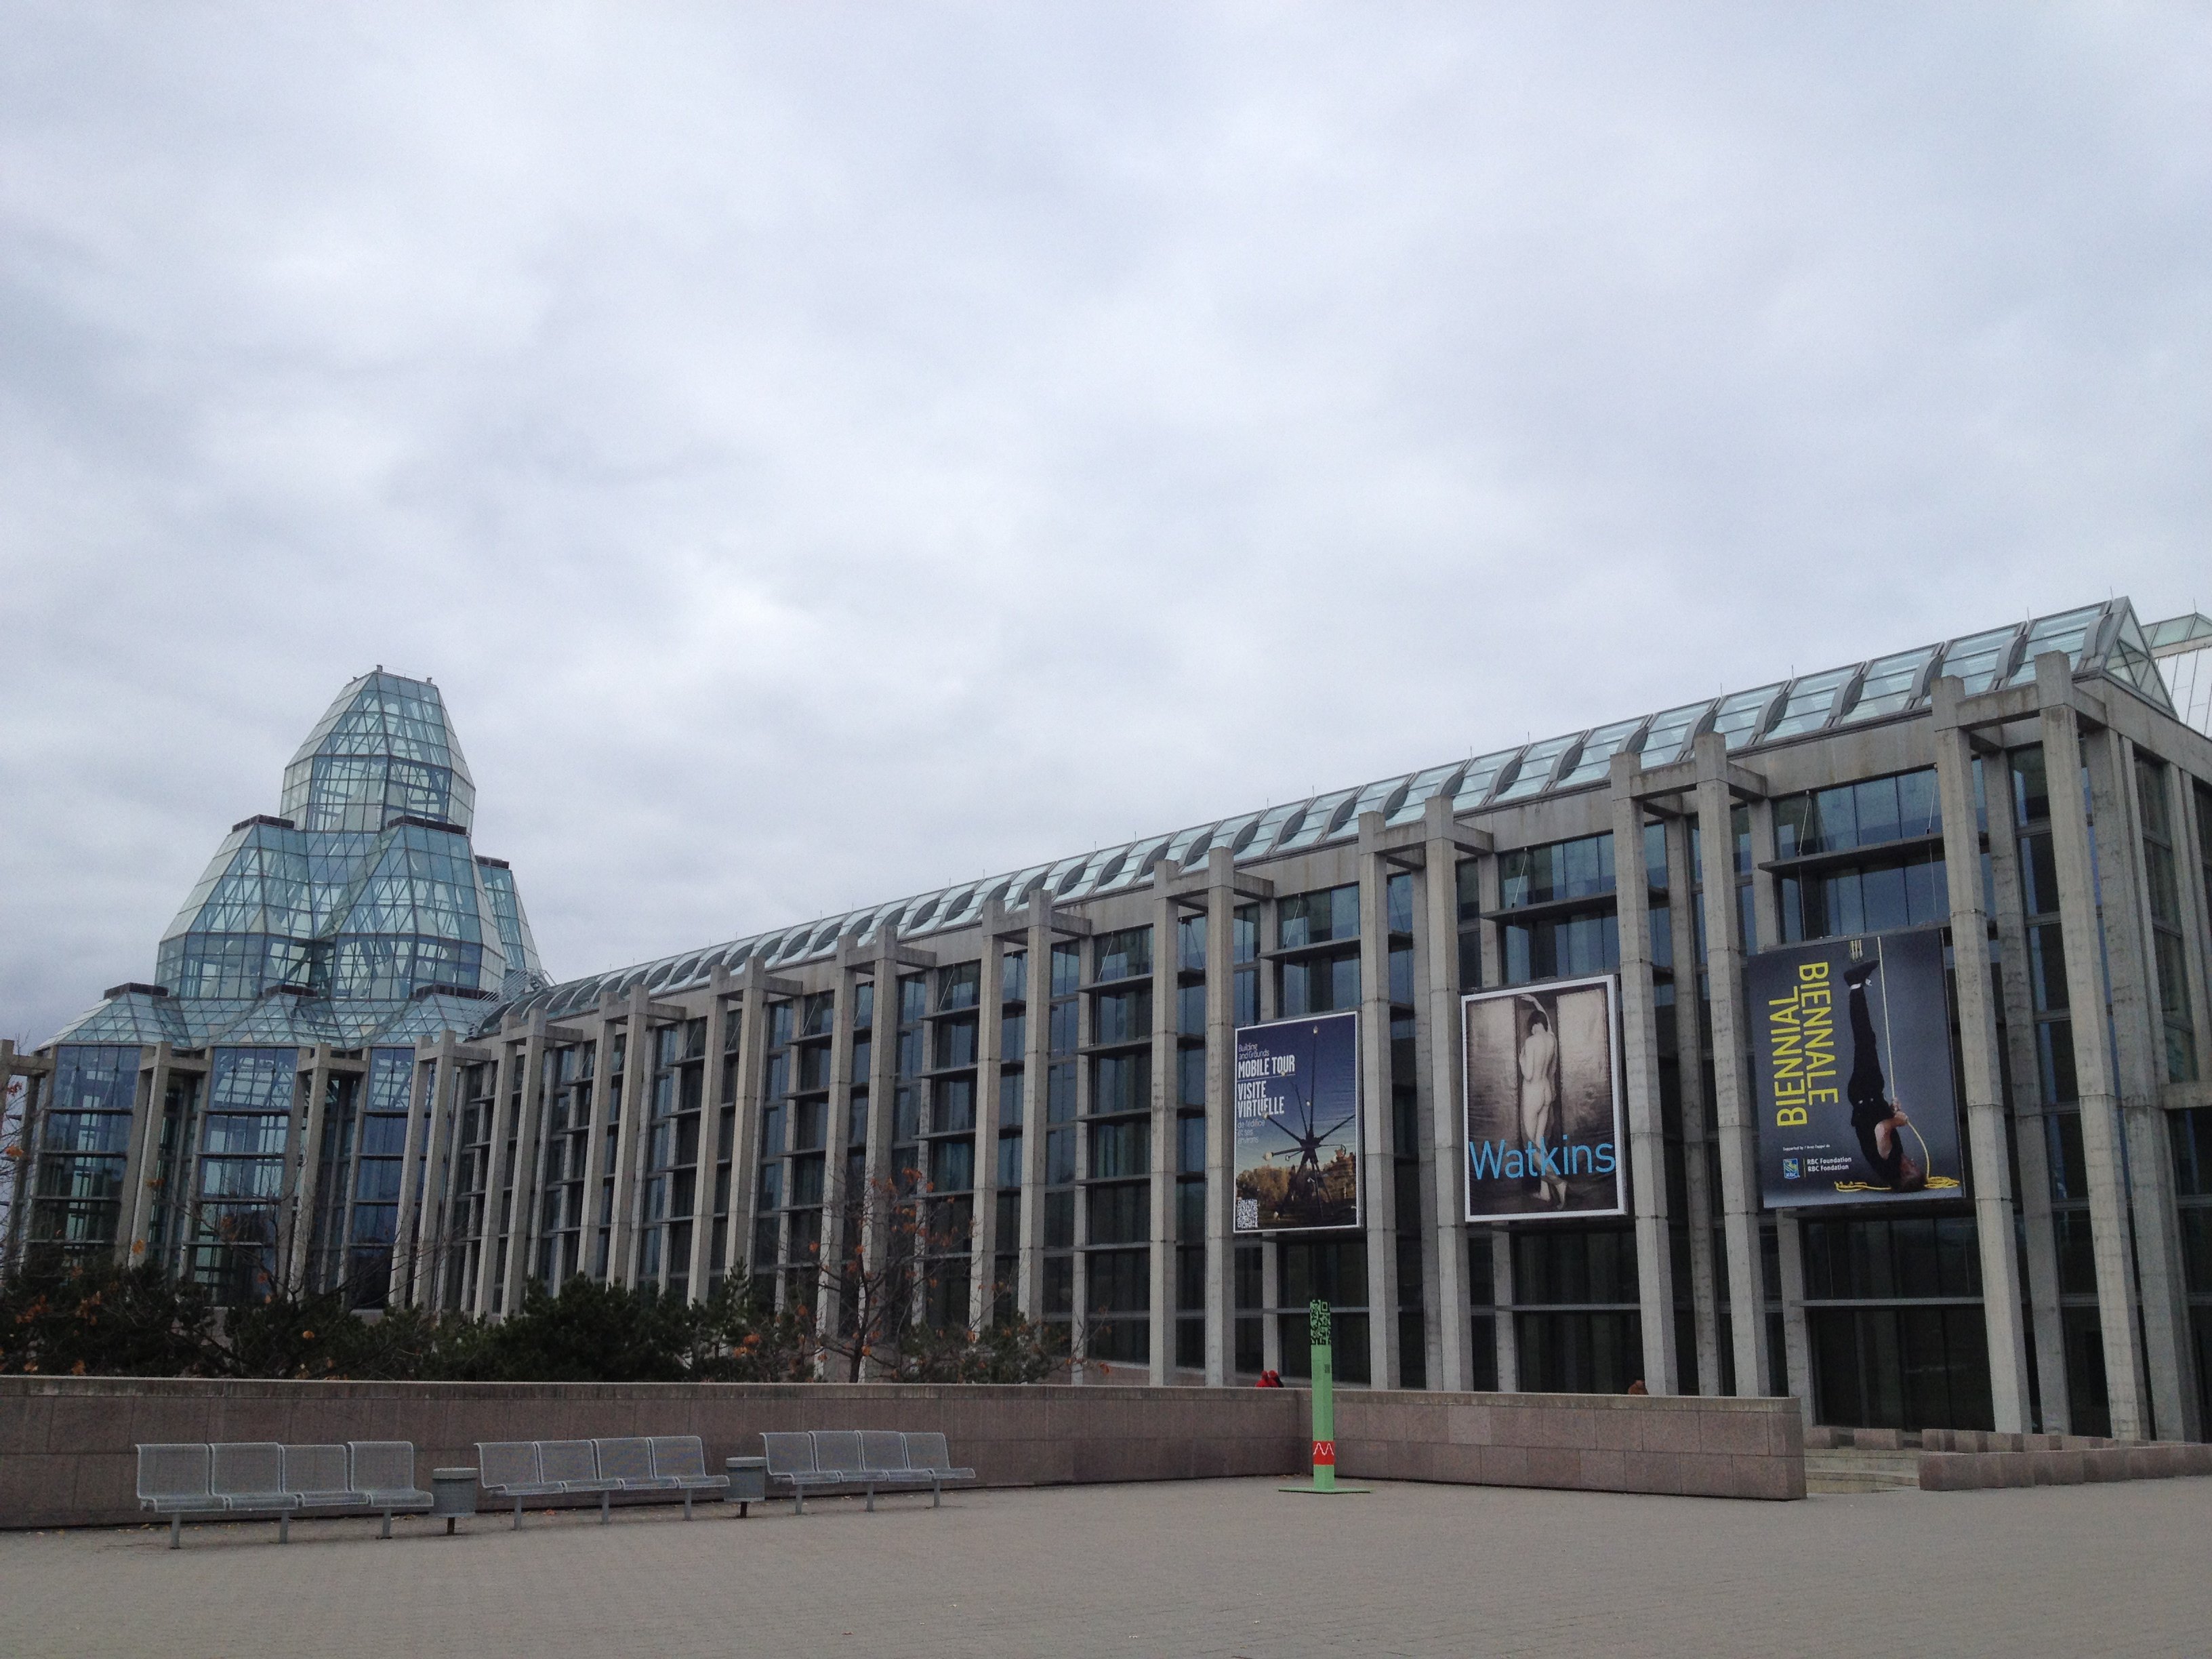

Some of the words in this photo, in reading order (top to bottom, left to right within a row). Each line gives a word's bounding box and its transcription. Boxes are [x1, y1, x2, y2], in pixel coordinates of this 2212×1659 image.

[1799, 962, 1838, 1105] BIENNALE
[1238, 1043, 1258, 1052] Building
[1238, 1051, 1248, 1060] and
[1248, 1048, 1269, 1059] Grounds
[1769, 985, 1807, 1126] BIENNIAL
[1238, 1058, 1269, 1078] MOBILE
[1271, 1054, 1295, 1075] TOUR
[1237, 1080, 1267, 1101] VISITE
[1237, 1096, 1285, 1118] VIRTUELLE
[1469, 1134, 1616, 1180] Watkins
[1820, 1156, 1852, 1164] Foundation
[1820, 1164, 1849, 1172] Fondation
